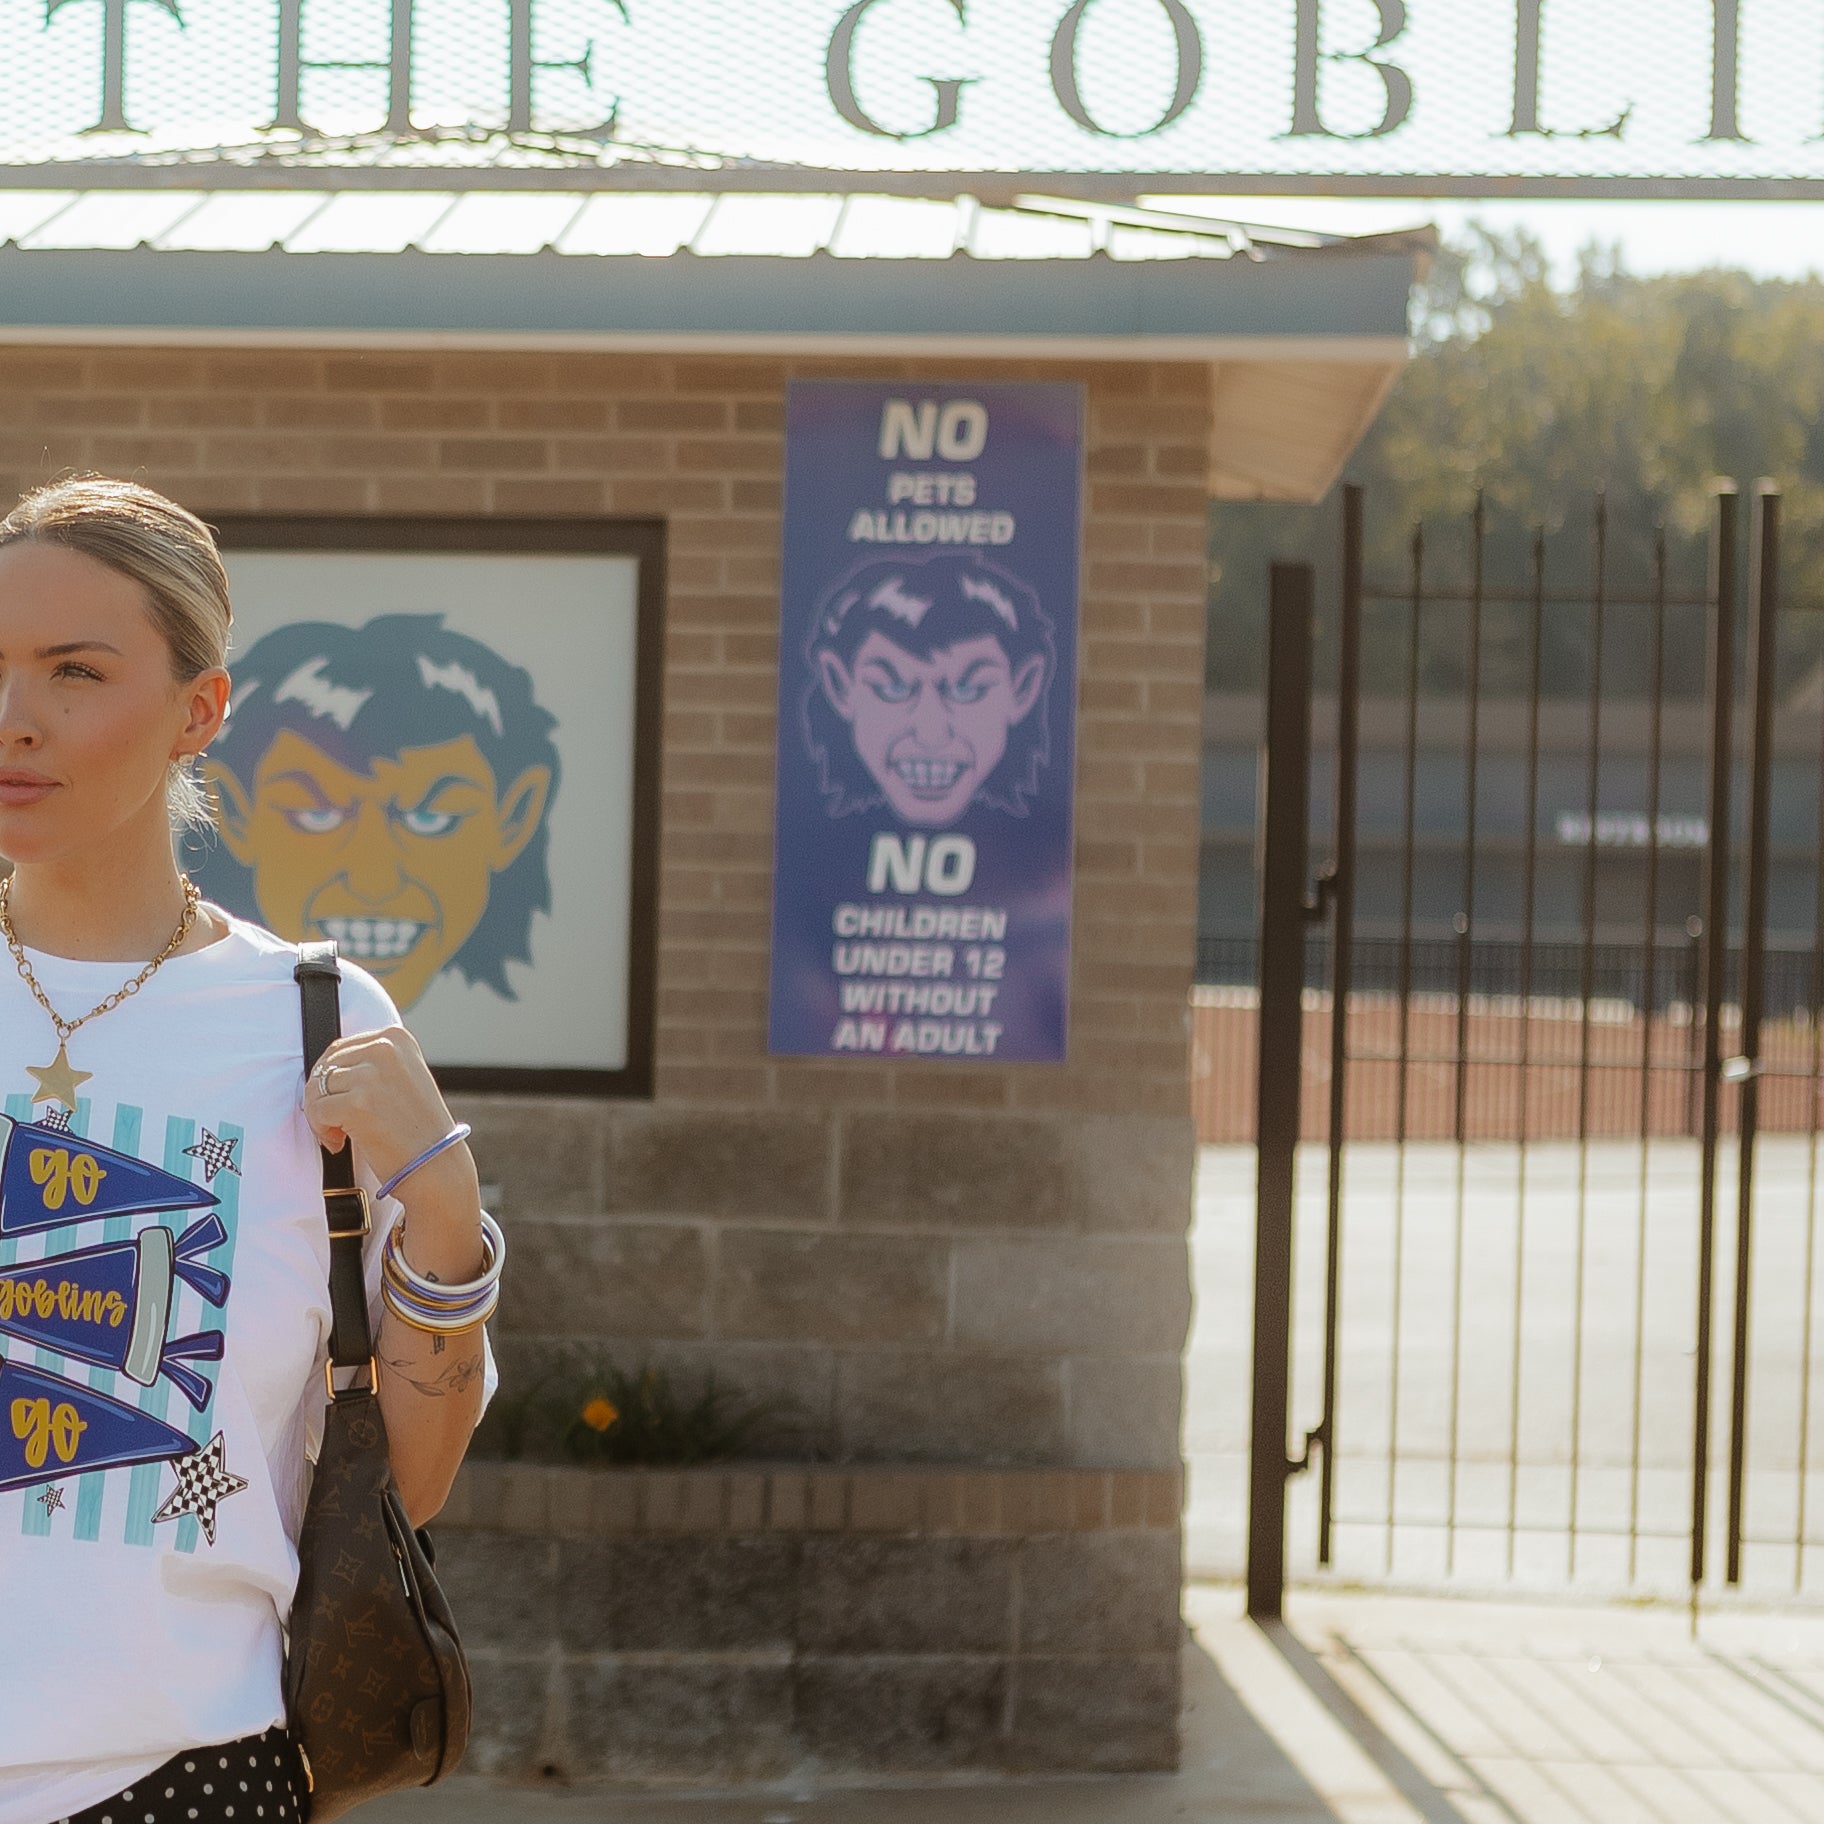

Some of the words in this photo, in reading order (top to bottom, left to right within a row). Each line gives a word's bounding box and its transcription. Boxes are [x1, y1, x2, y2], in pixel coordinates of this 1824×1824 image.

[878, 398, 989, 462] NO
[887, 471, 976, 506] PETS
[848, 509, 1016, 545] ALLOWED
[866, 833, 977, 896] NO
[832, 903, 1008, 941] CHILDREN
[832, 943, 953, 978] UNDER
[964, 945, 1006, 980] 12
[840, 980, 998, 1017] WITHOUT
[832, 1017, 888, 1051] AN
[890, 1018, 1003, 1055] ADULT
[29, 1146, 107, 1211] go
[10, 1397, 87, 1469] go
